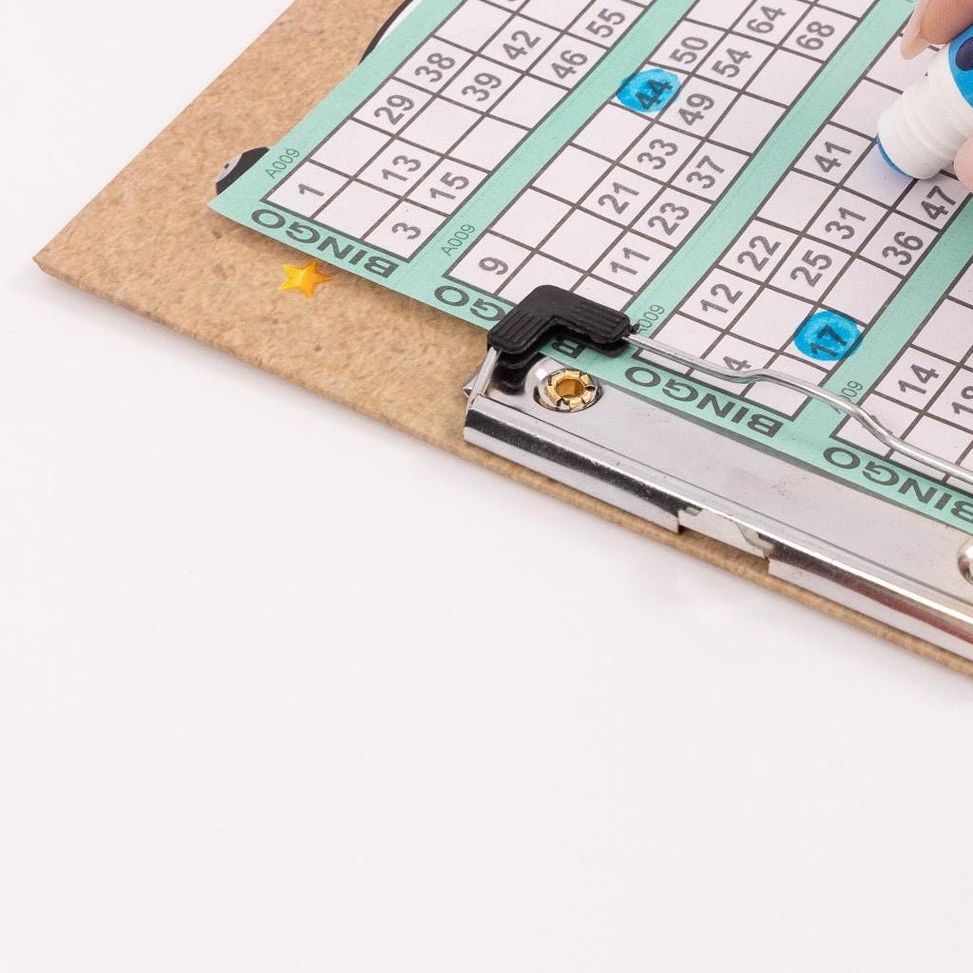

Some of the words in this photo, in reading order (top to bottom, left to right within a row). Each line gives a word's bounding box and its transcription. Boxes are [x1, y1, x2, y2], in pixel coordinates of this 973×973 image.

[265, 148, 301, 180] A009
[299, 184, 324, 196] 1
[374, 95, 414, 125] 29
[415, 53, 455, 82] 38
[382, 155, 421, 181] 13
[462, 73, 501, 101] 39
[503, 31, 541, 59] 42
[392, 223, 421, 239] 3
[430, 172, 469, 199] 15
[552, 50, 587, 79] 46
[586, 8, 625, 37] 55
[479, 257, 508, 275] 9
[635, 80, 672, 110] 44
[669, 37, 708, 64] 50
[598, 182, 639, 214] 21
[637, 139, 678, 169] 33
[679, 94, 714, 125] 49
[712, 49, 751, 77] 54
[747, 6, 785, 33] 64
[610, 247, 650, 275] 11
[648, 203, 689, 235] 23
[686, 156, 724, 188] 37
[796, 22, 834, 50] 68
[251, 208, 401, 280] BINGO
[441, 223, 476, 257] A009
[701, 284, 743, 313] 12
[737, 236, 781, 271] 22
[815, 142, 851, 172] 41
[723, 356, 751, 371] 4
[791, 250, 832, 287] 25
[825, 207, 866, 239] 31
[810, 325, 847, 357] 17
[882, 232, 923, 265] 36
[921, 185, 956, 219] 47
[625, 366, 785, 438] BINGO
[898, 364, 939, 394] 14
